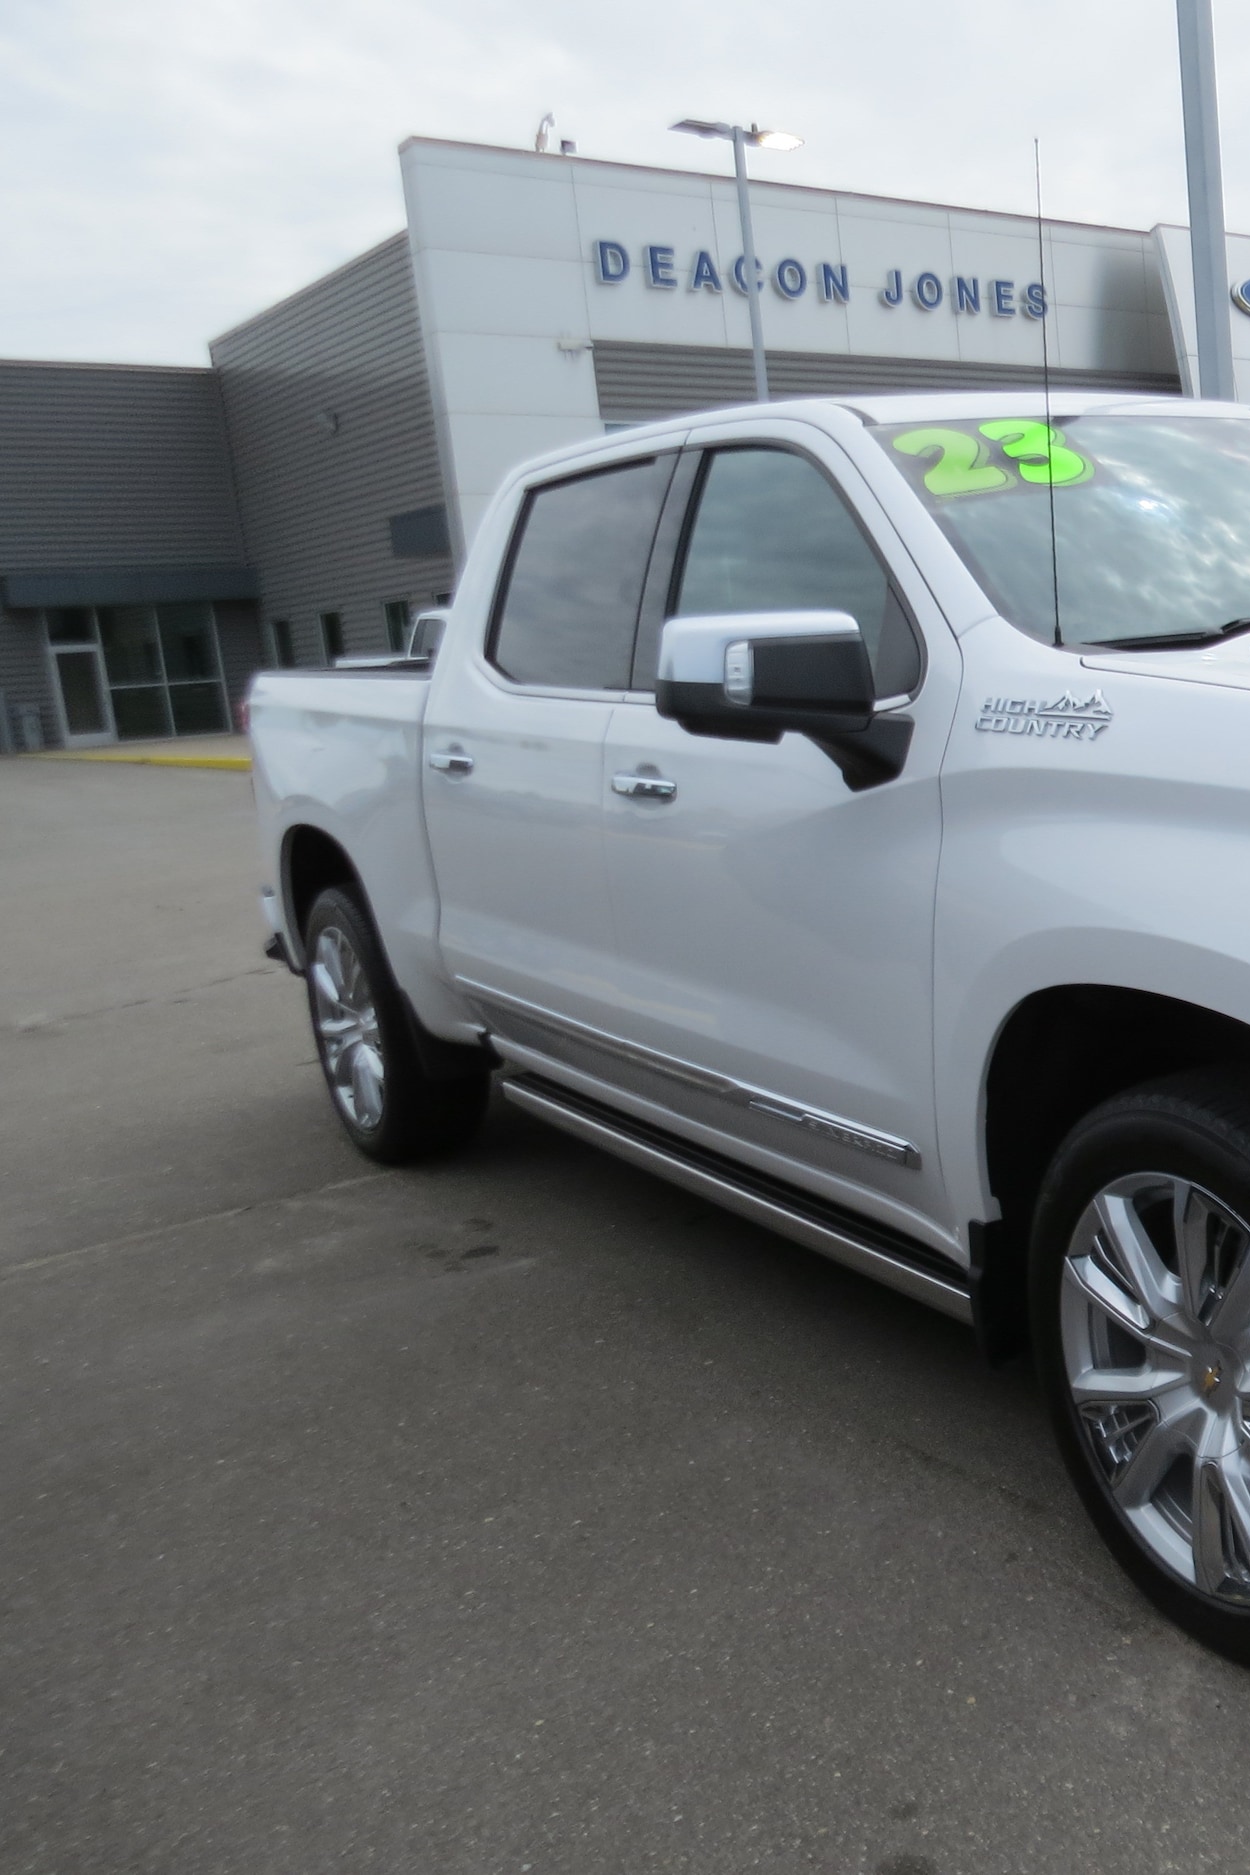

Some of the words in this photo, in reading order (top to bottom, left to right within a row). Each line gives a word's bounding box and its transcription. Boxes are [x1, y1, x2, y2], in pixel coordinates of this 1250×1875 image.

[594, 240, 850, 303] DEACON
[880, 268, 1050, 320] JONES
[892, 419, 1095, 500] 23
[975, 716, 1109, 741] COUNTRY
[980, 697, 1047, 715] HIGH
